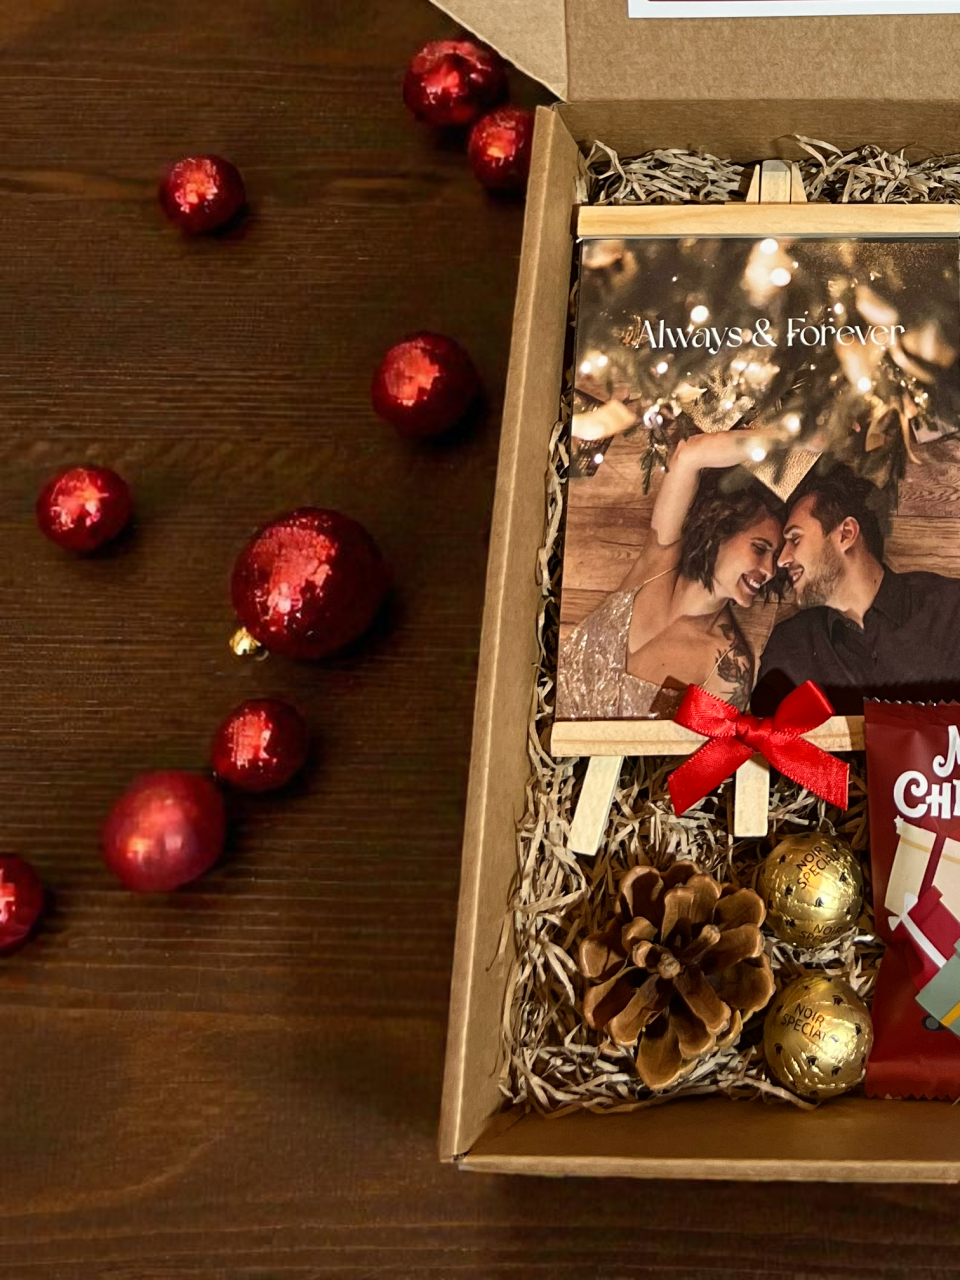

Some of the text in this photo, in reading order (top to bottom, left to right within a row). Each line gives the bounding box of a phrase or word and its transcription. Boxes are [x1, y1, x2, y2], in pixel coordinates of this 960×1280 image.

[635, 317, 906, 355] Always & Forever
[796, 845, 826, 872] NOIR
[797, 852, 840, 890] SPECIAL
[798, 930, 834, 943] SPEC
[793, 1002, 825, 1028] NOIR
